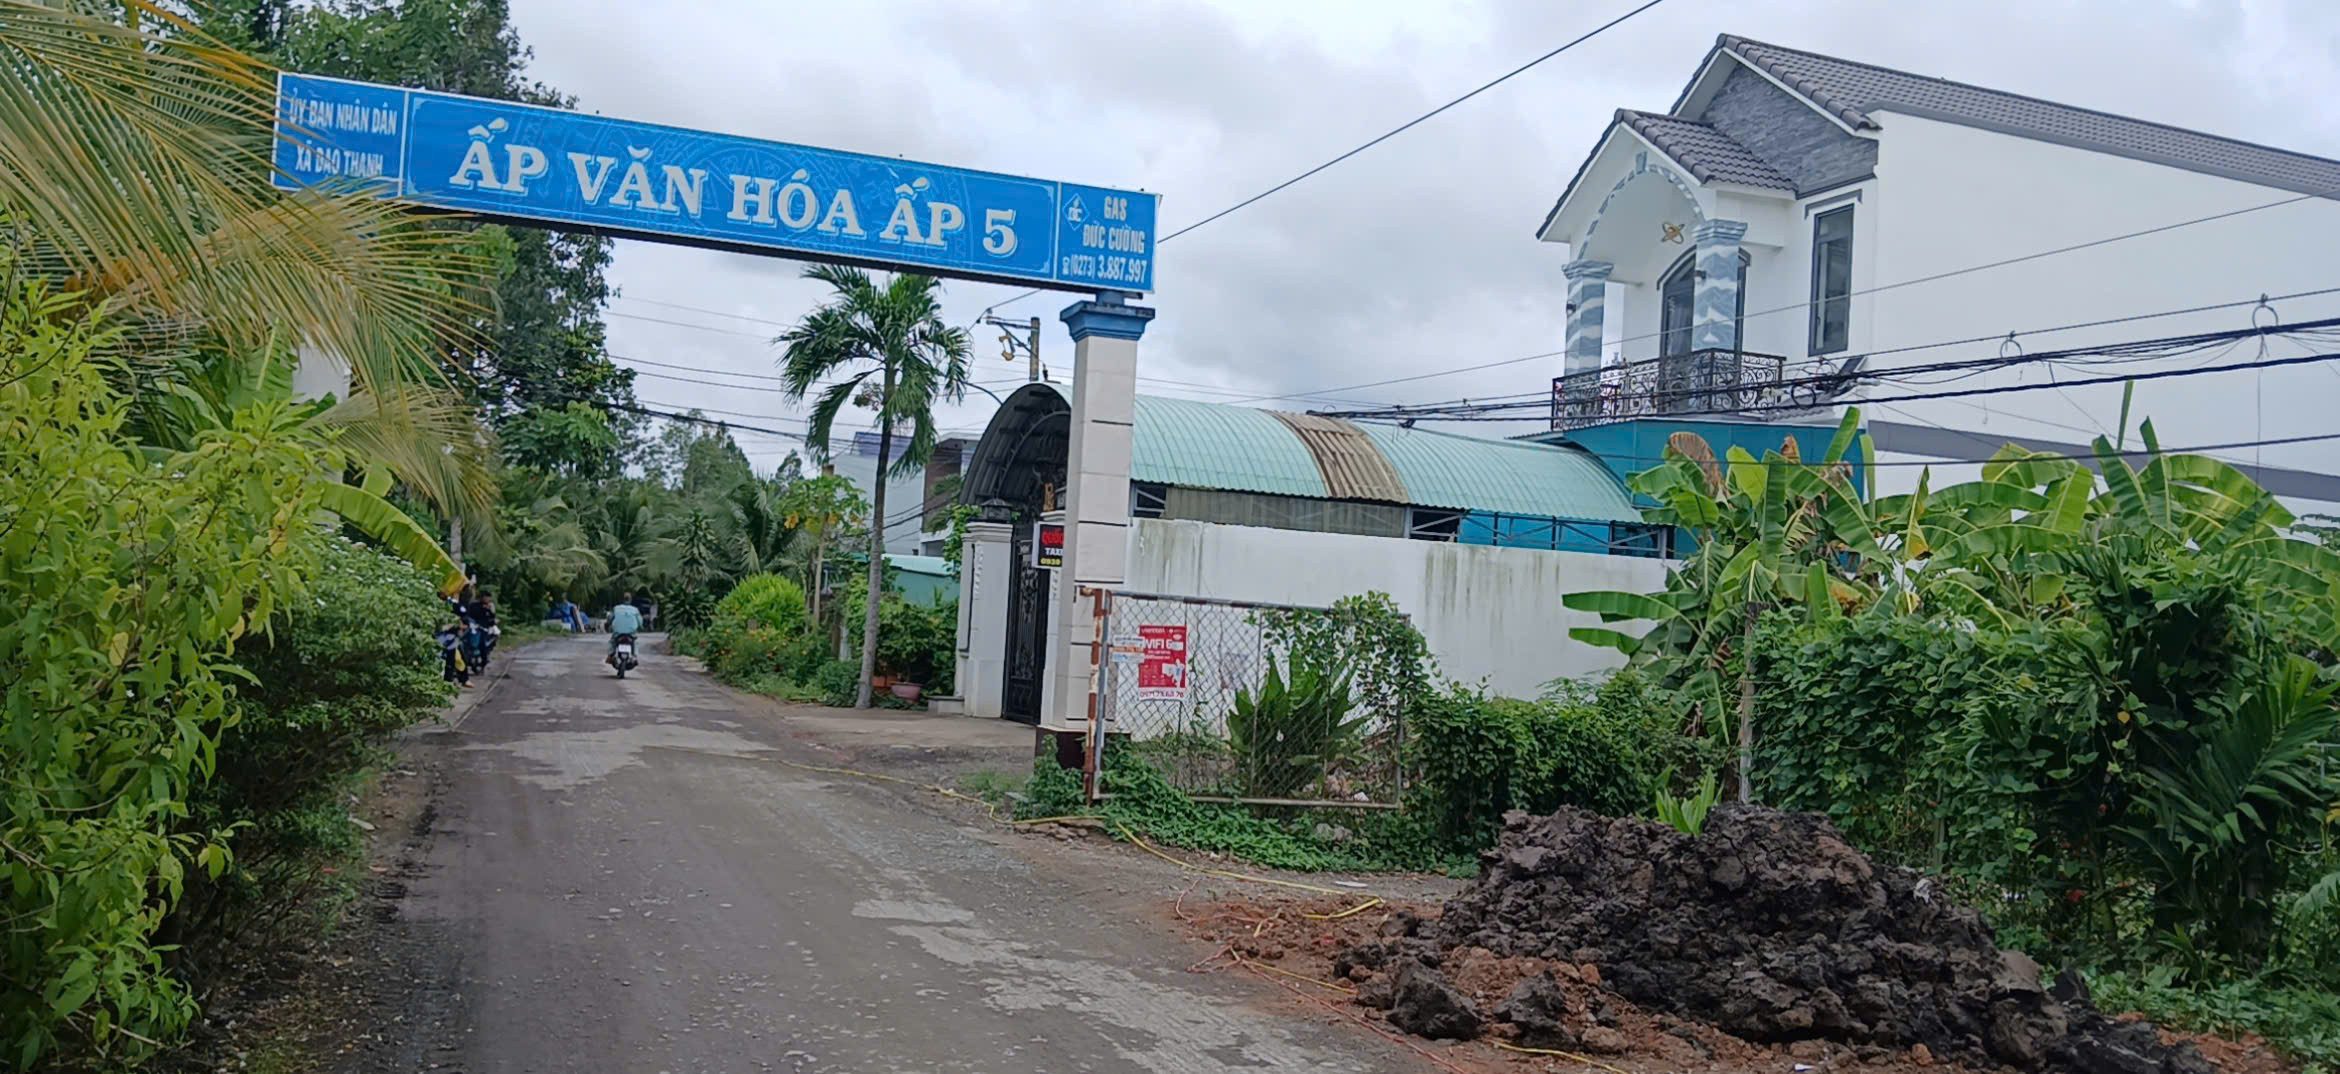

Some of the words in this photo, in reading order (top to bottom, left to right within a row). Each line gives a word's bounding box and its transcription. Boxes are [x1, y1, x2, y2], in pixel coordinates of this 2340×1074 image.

[309, 100, 334, 128] BAN
[336, 98, 370, 133] NHÂN
[371, 102, 398, 136] DÂN
[449, 117, 548, 196] ẤP
[567, 145, 707, 217] VĂN
[727, 168, 866, 240] HÓA
[880, 176, 965, 250] ẤP
[983, 208, 1018, 258] 5
[1104, 196, 1128, 221] GAS
[1097, 254, 1147, 283] 3.887.997
